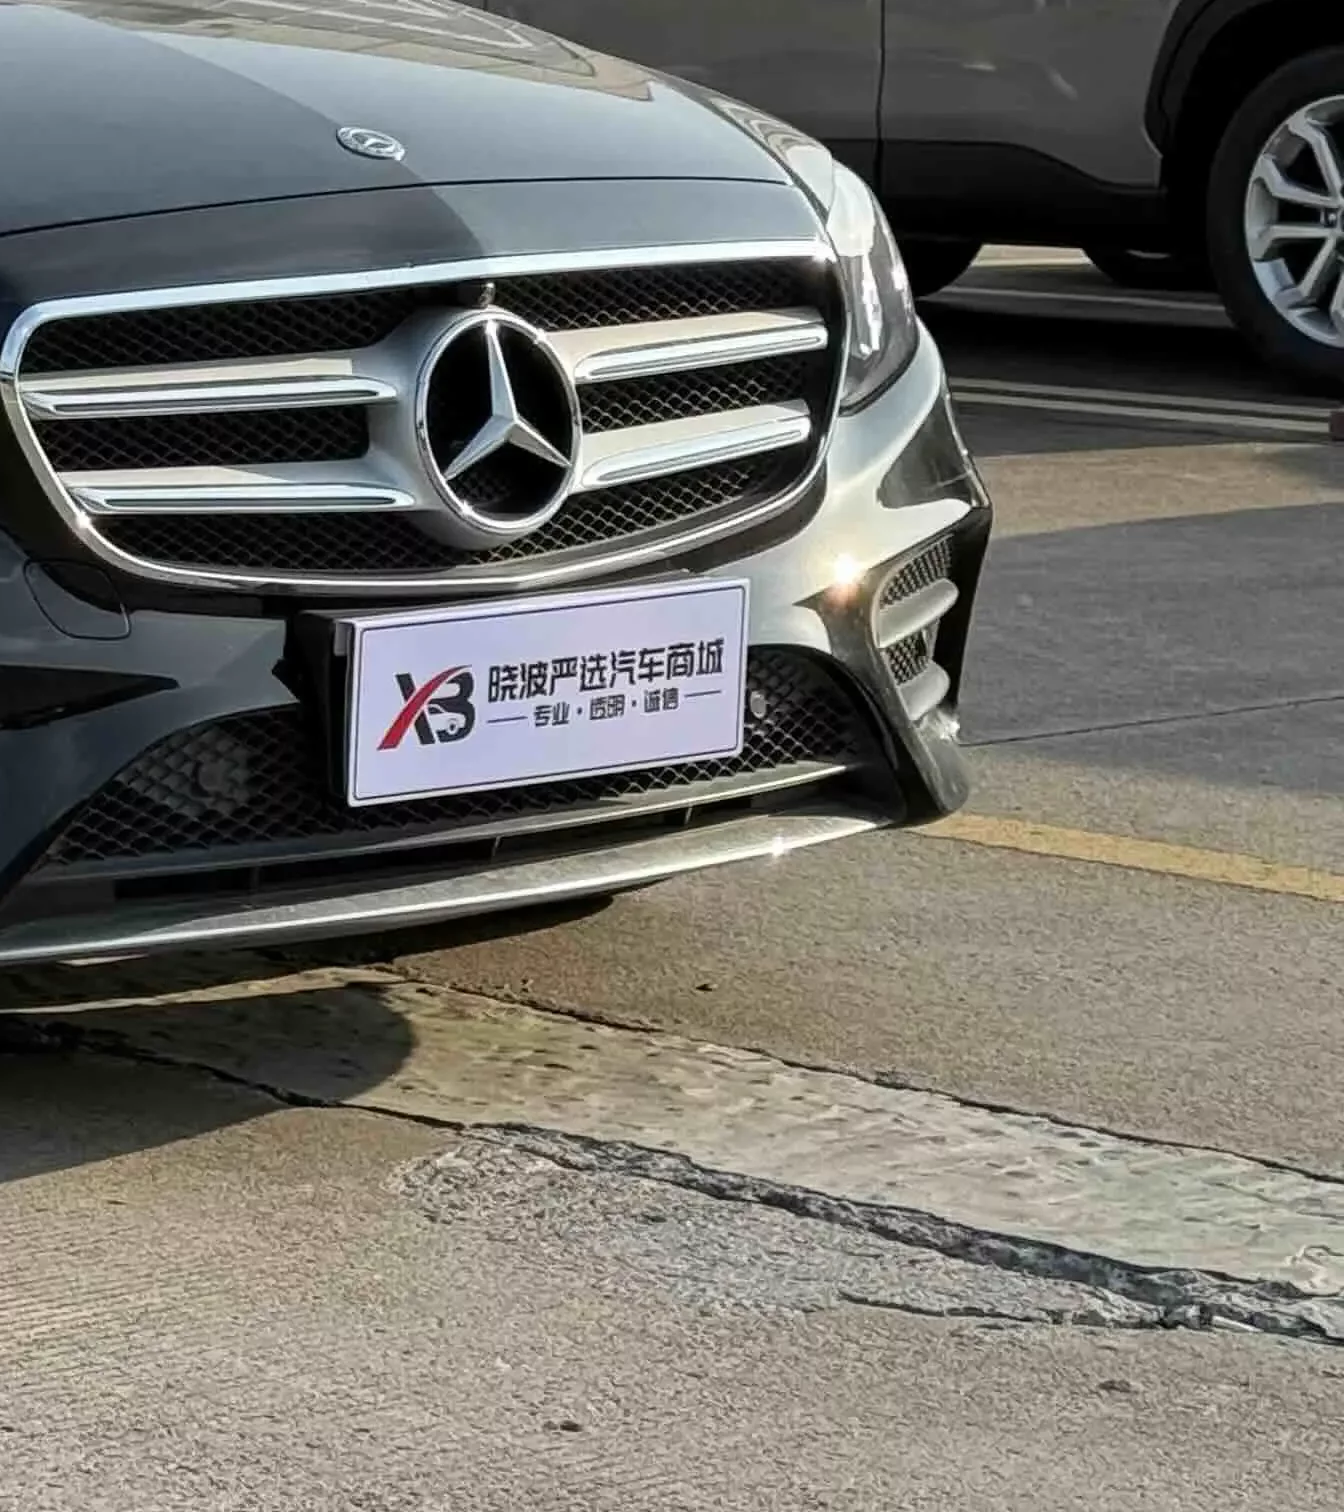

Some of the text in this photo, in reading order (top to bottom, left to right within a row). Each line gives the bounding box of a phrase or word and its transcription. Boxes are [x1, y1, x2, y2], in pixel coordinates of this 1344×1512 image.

[488, 637, 724, 703] 晓波严选汽车商城
